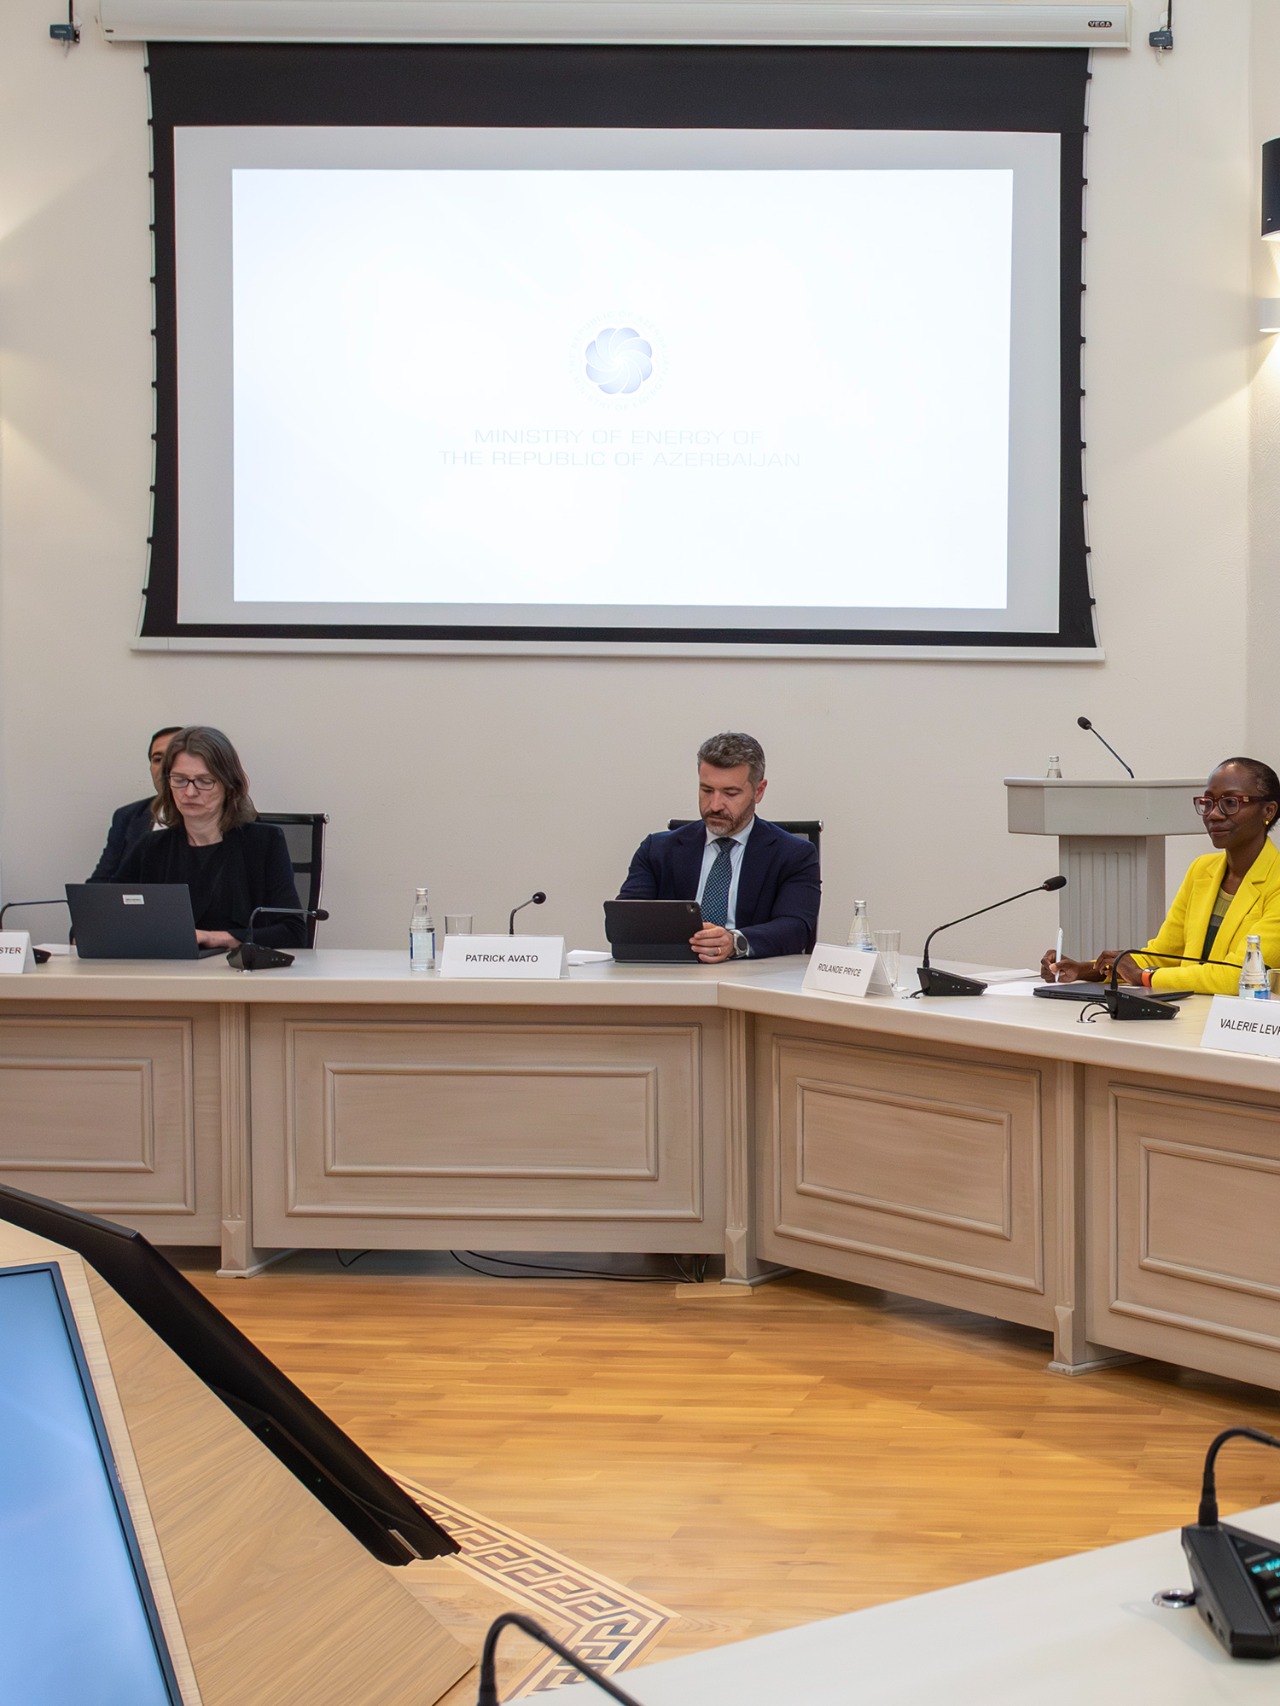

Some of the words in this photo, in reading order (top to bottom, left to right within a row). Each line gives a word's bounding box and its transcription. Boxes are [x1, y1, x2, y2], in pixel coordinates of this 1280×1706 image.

[474, 429, 585, 445] MINISTRY
[592, 429, 625, 445] OF
[631, 430, 726, 446] ENERGY
[733, 430, 763, 446] OF
[439, 450, 484, 466] THE
[492, 450, 607, 467] REPUBLIC
[614, 451, 646, 467] OF
[652, 452, 802, 468] AZERBAIJAN
[465, 954, 506, 963] PATRICK
[507, 955, 539, 963] AVATO
[843, 966, 862, 977] PRYCE
[1220, 1018, 1258, 1033] VALERIE
